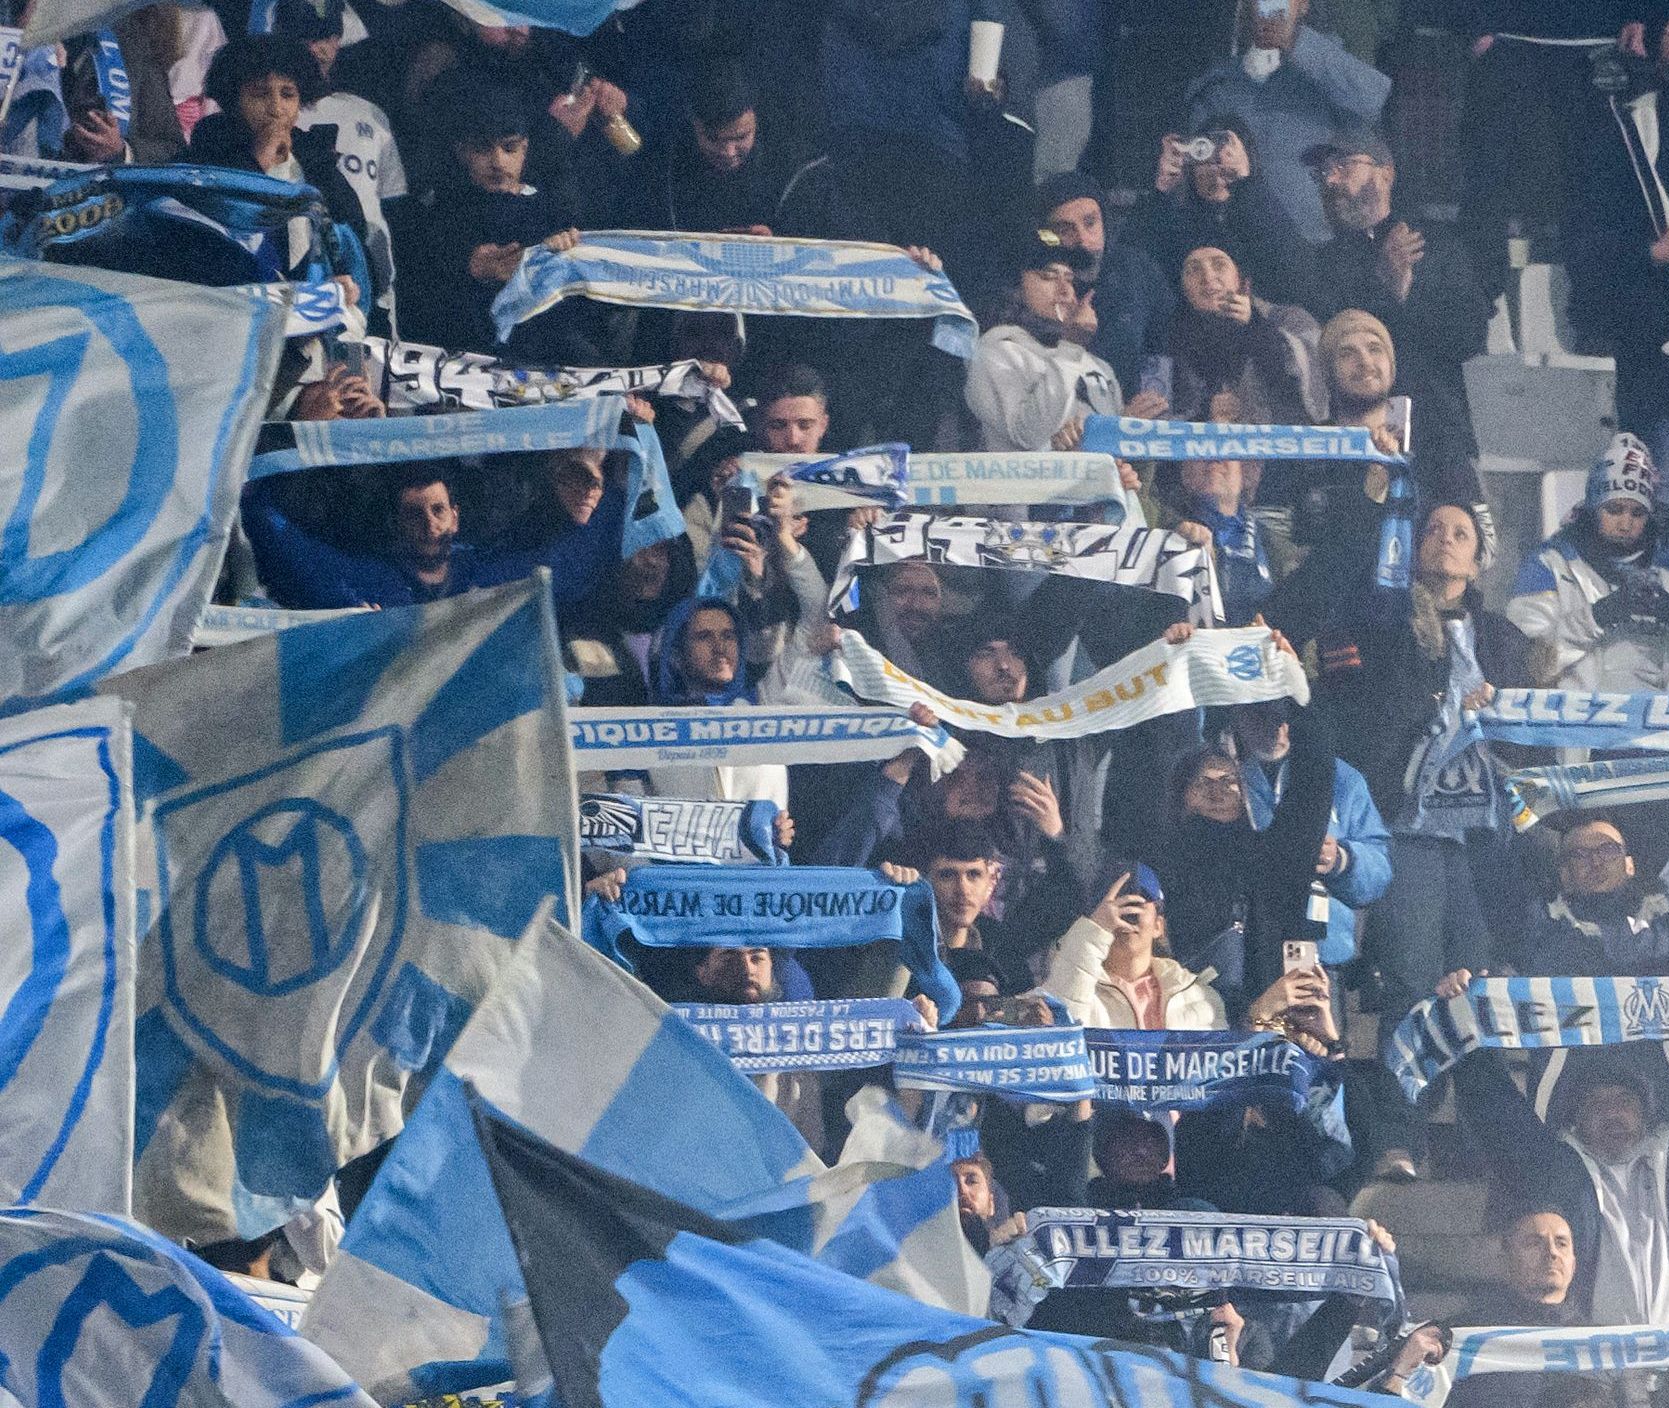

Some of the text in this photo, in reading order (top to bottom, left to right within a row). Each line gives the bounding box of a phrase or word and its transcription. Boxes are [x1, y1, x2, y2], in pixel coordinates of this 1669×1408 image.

[1119, 438, 1388, 460] DE MARSEILL
[968, 459, 1100, 482] MARSEILLE
[571, 716, 679, 748] PIQUE
[982, 1042, 1019, 1061] QUI
[1126, 1049, 1301, 1081] DE MARSEILLE
[1050, 1224, 1380, 1264] ALLEZ MARSEILL
